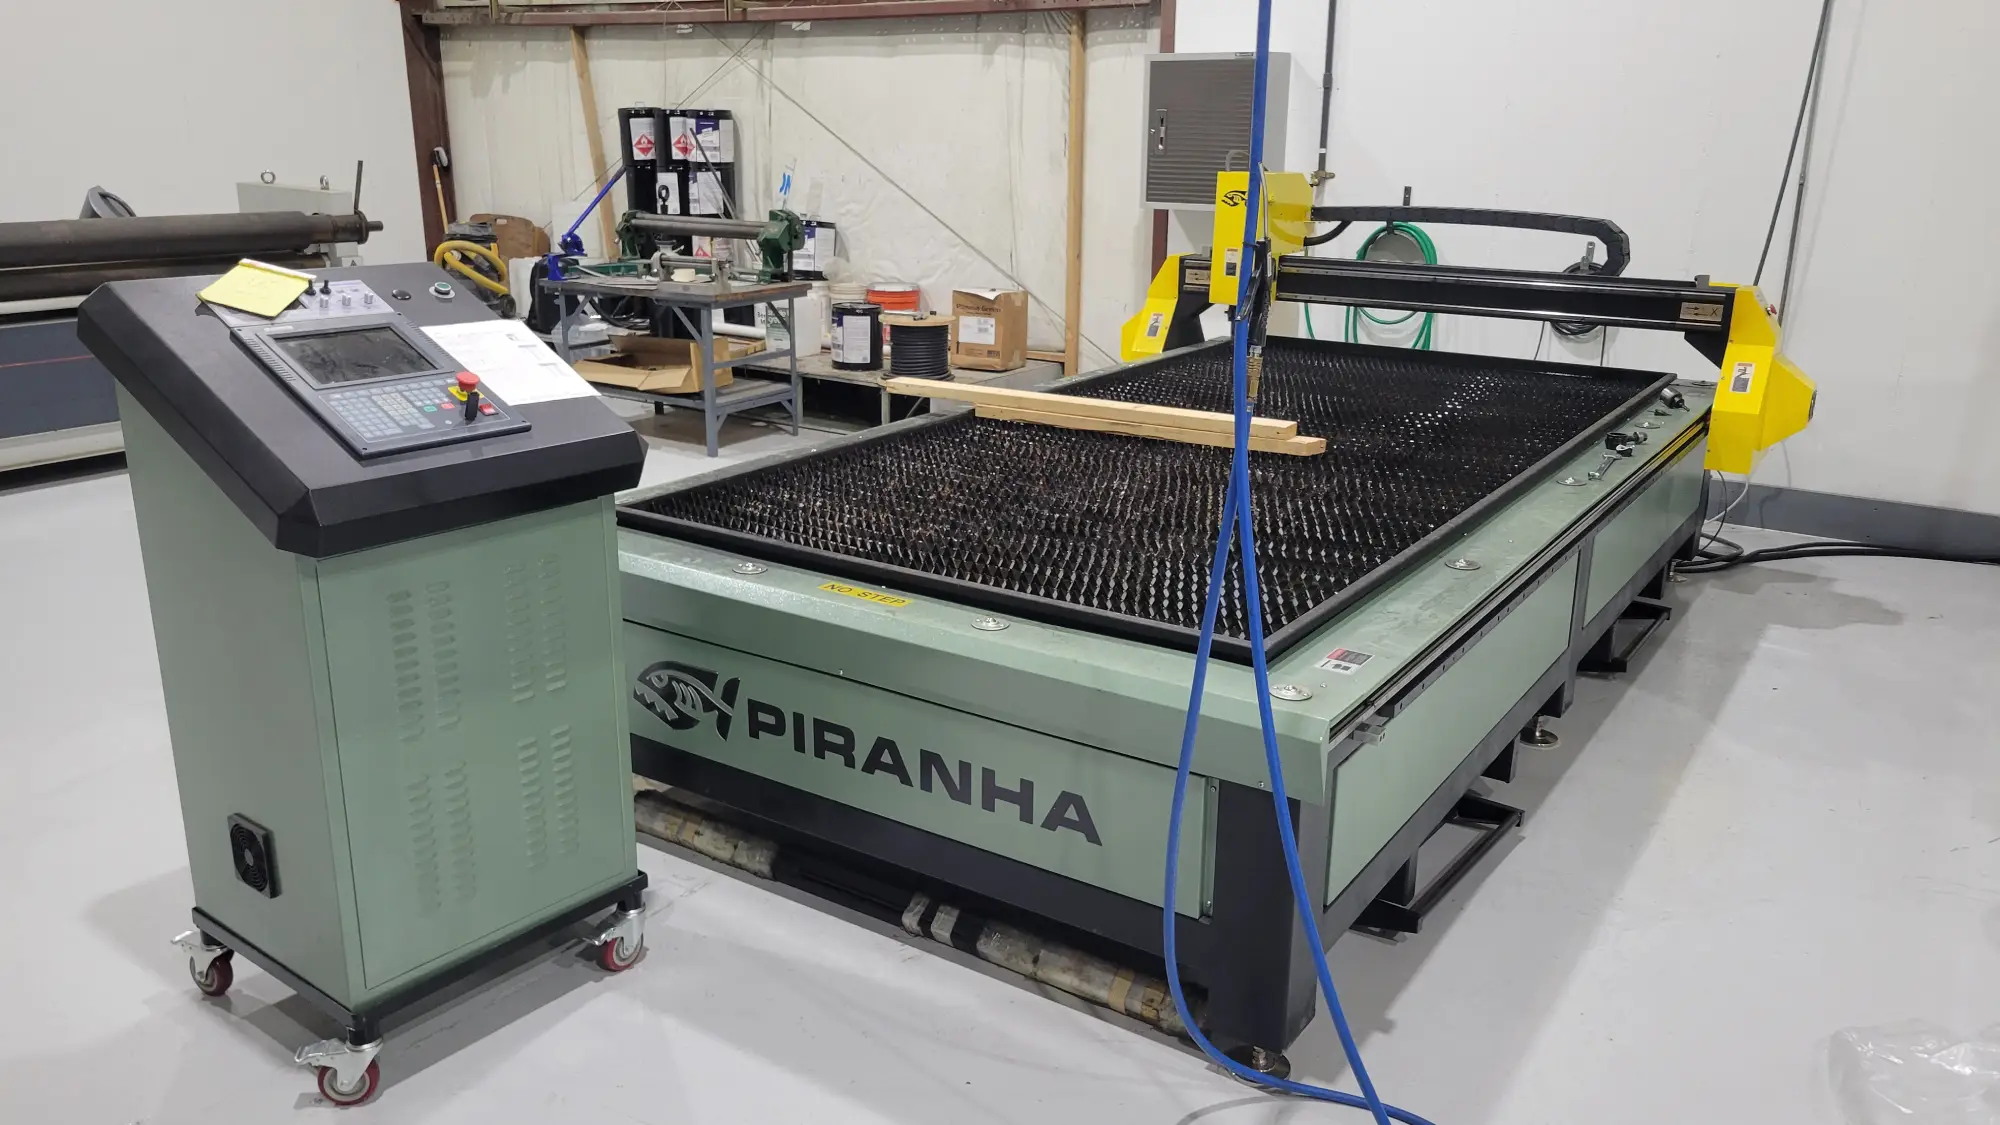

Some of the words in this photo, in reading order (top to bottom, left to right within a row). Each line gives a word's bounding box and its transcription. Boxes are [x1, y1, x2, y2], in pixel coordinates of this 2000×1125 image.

[823, 583, 853, 593] NO
[857, 591, 906, 605] STEP
[747, 698, 1102, 846] PIRANHA
